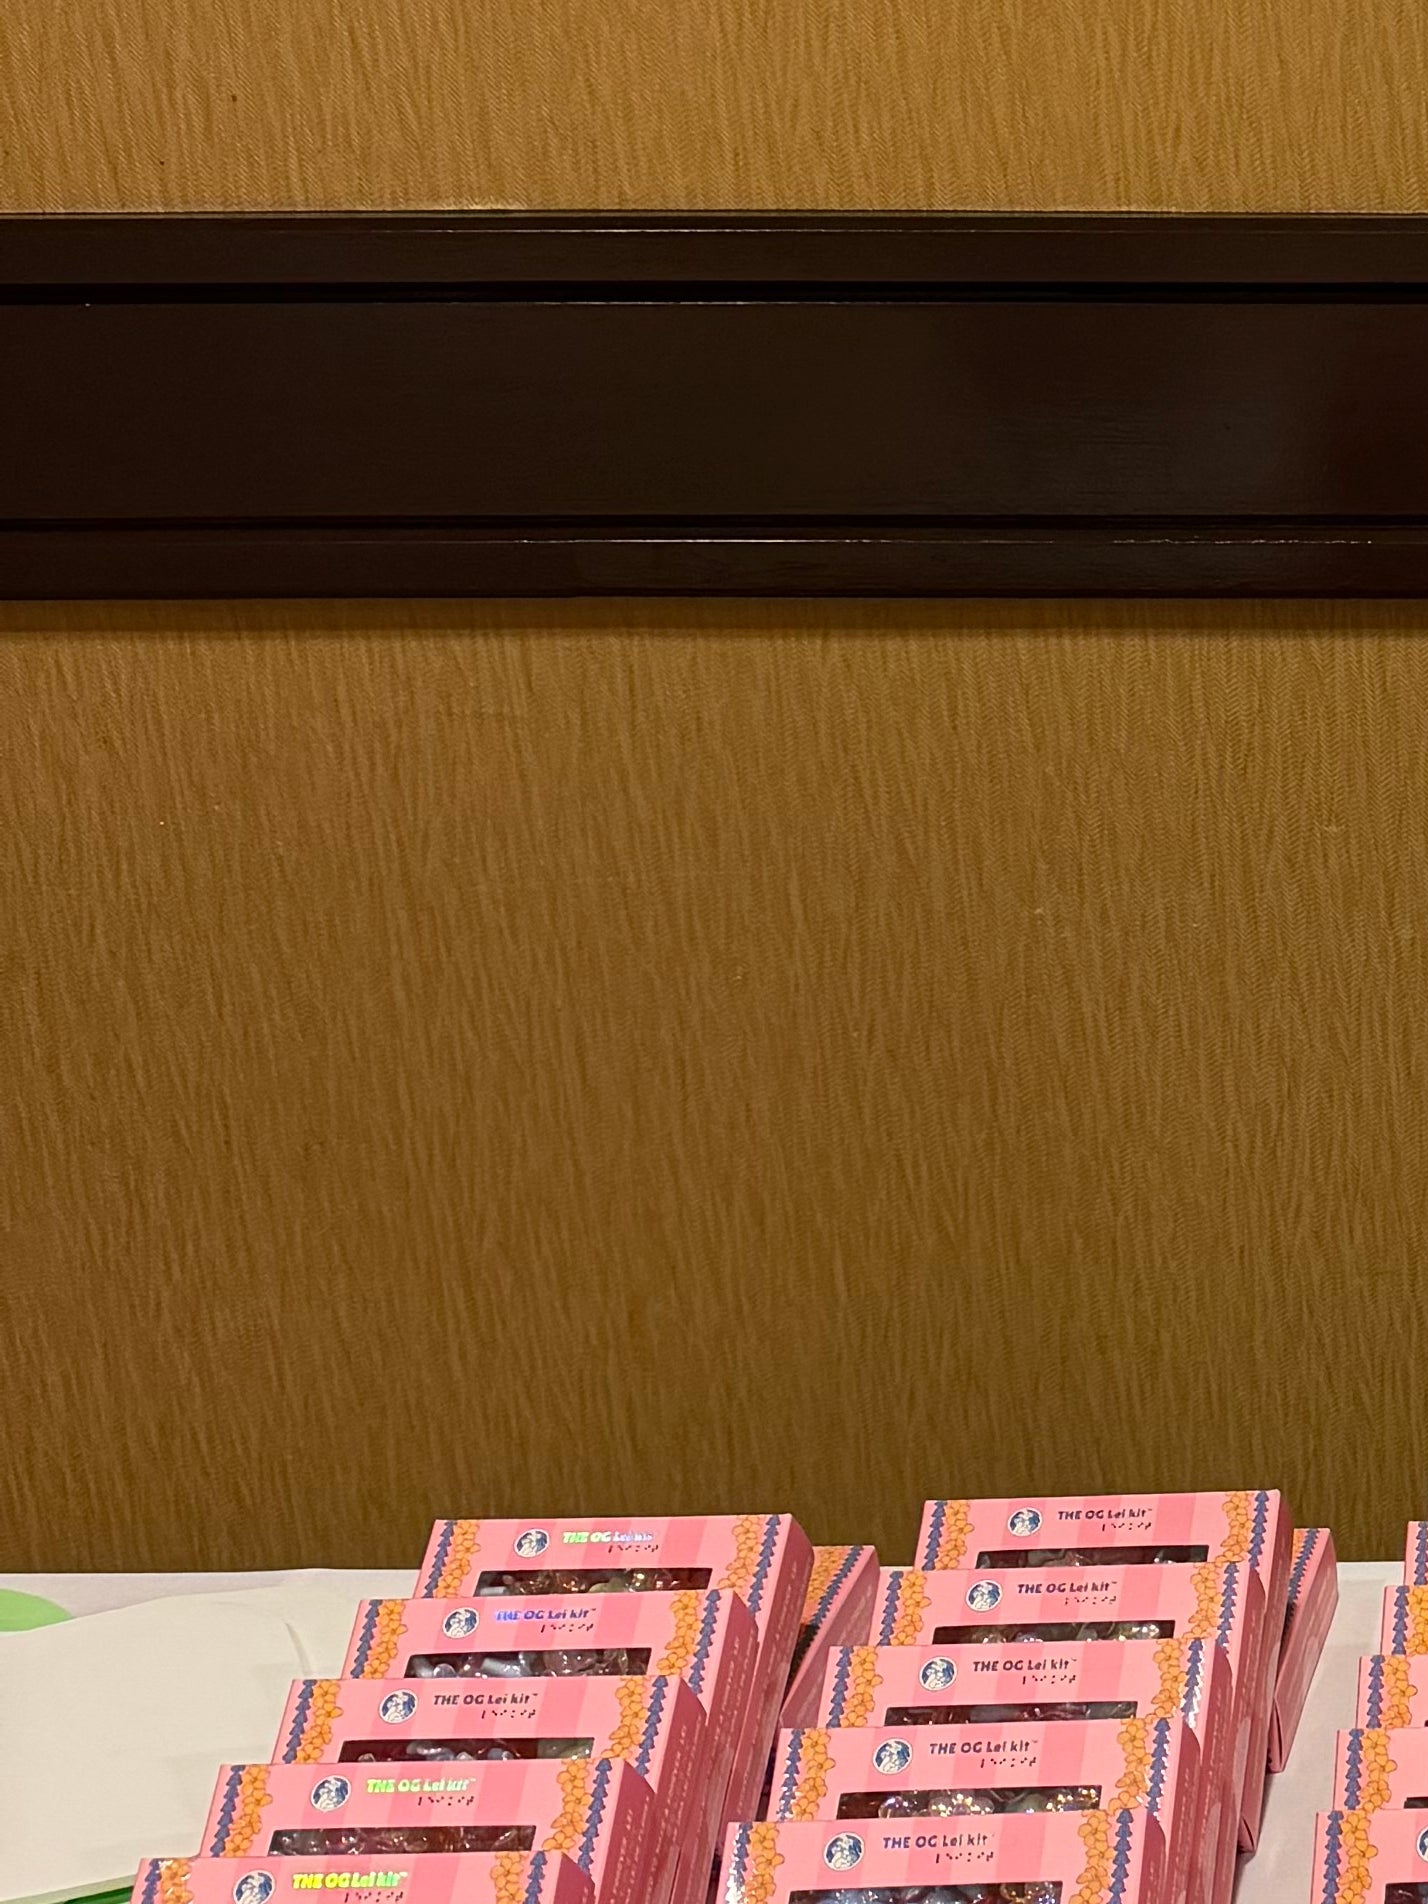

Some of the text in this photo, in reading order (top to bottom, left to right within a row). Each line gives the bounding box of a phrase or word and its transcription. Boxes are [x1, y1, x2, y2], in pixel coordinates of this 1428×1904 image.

[433, 1694, 460, 1705] THE
[463, 1694, 484, 1705] OG
[487, 1693, 507, 1704] Lei
[929, 1743, 957, 1754] THE
[960, 1742, 983, 1753] OG
[986, 1741, 1007, 1753] Lei
